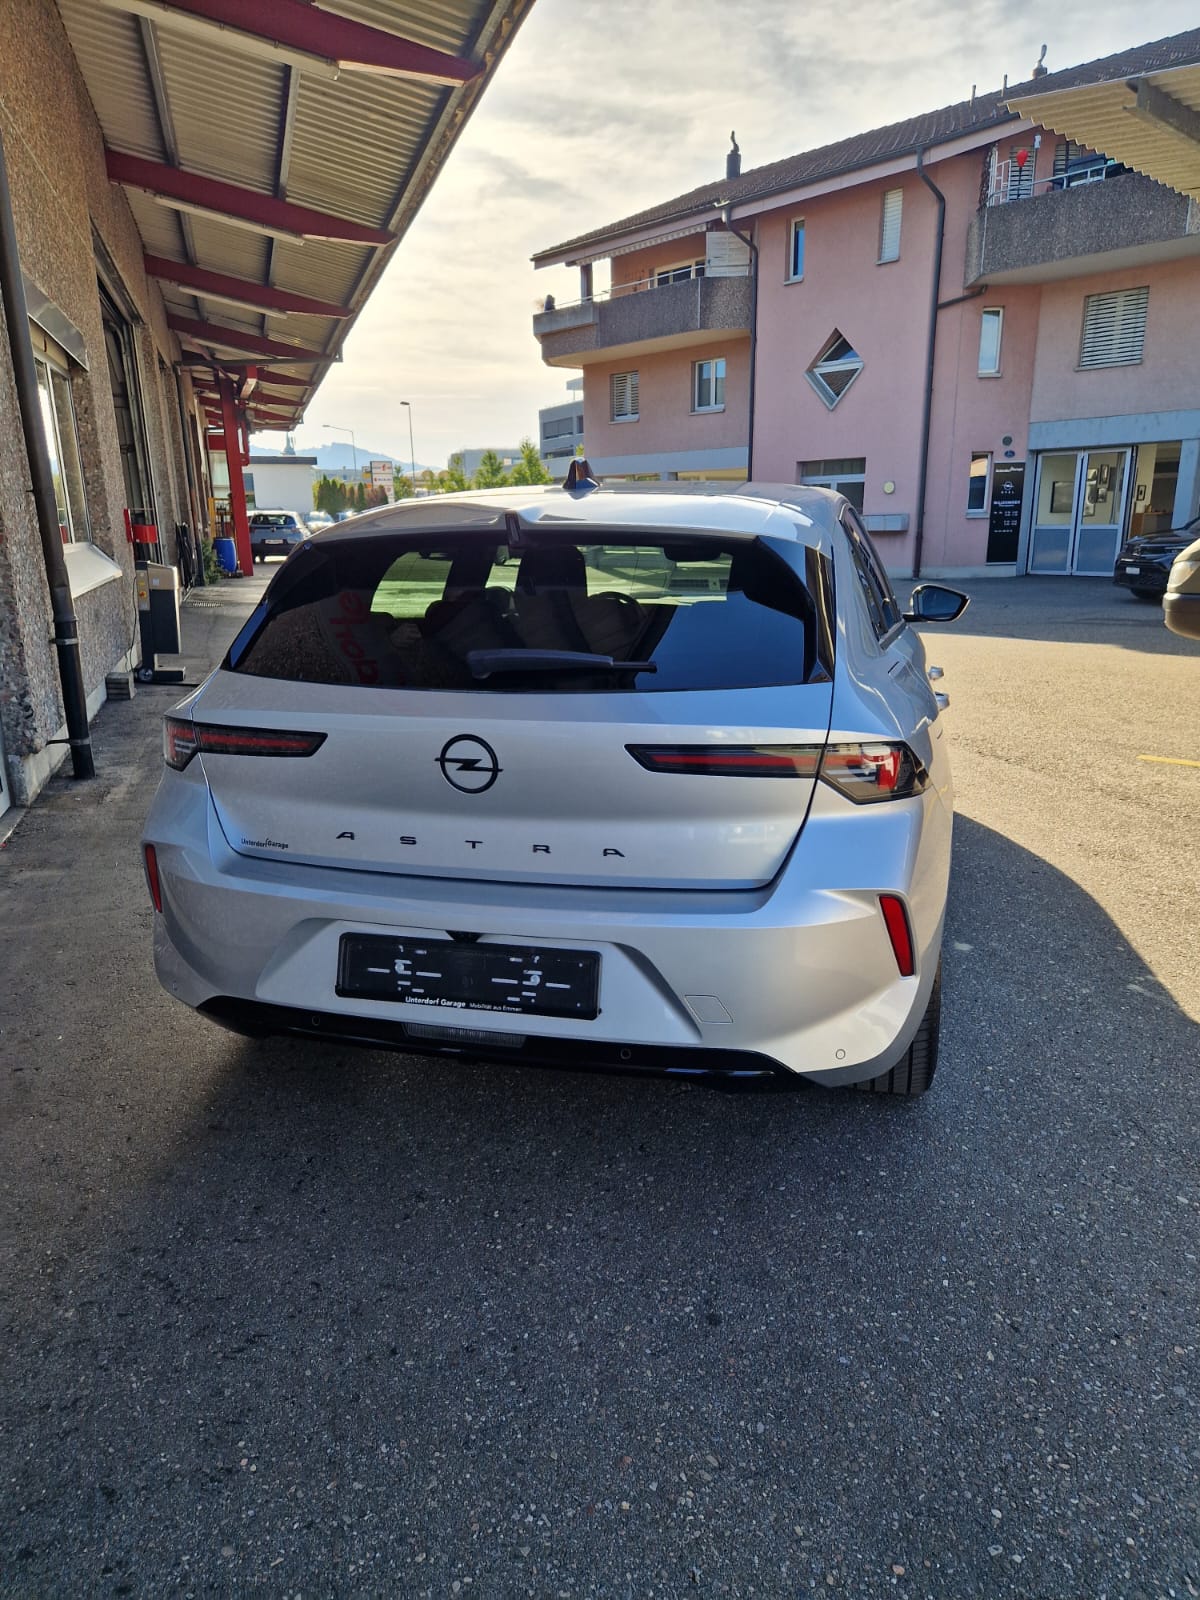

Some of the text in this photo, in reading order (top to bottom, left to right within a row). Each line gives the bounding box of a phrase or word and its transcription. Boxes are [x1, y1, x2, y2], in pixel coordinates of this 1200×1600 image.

[336, 831, 625, 858] ASTRA
[405, 996, 439, 1006] Unterdorf
[440, 998, 466, 1008] Garage
